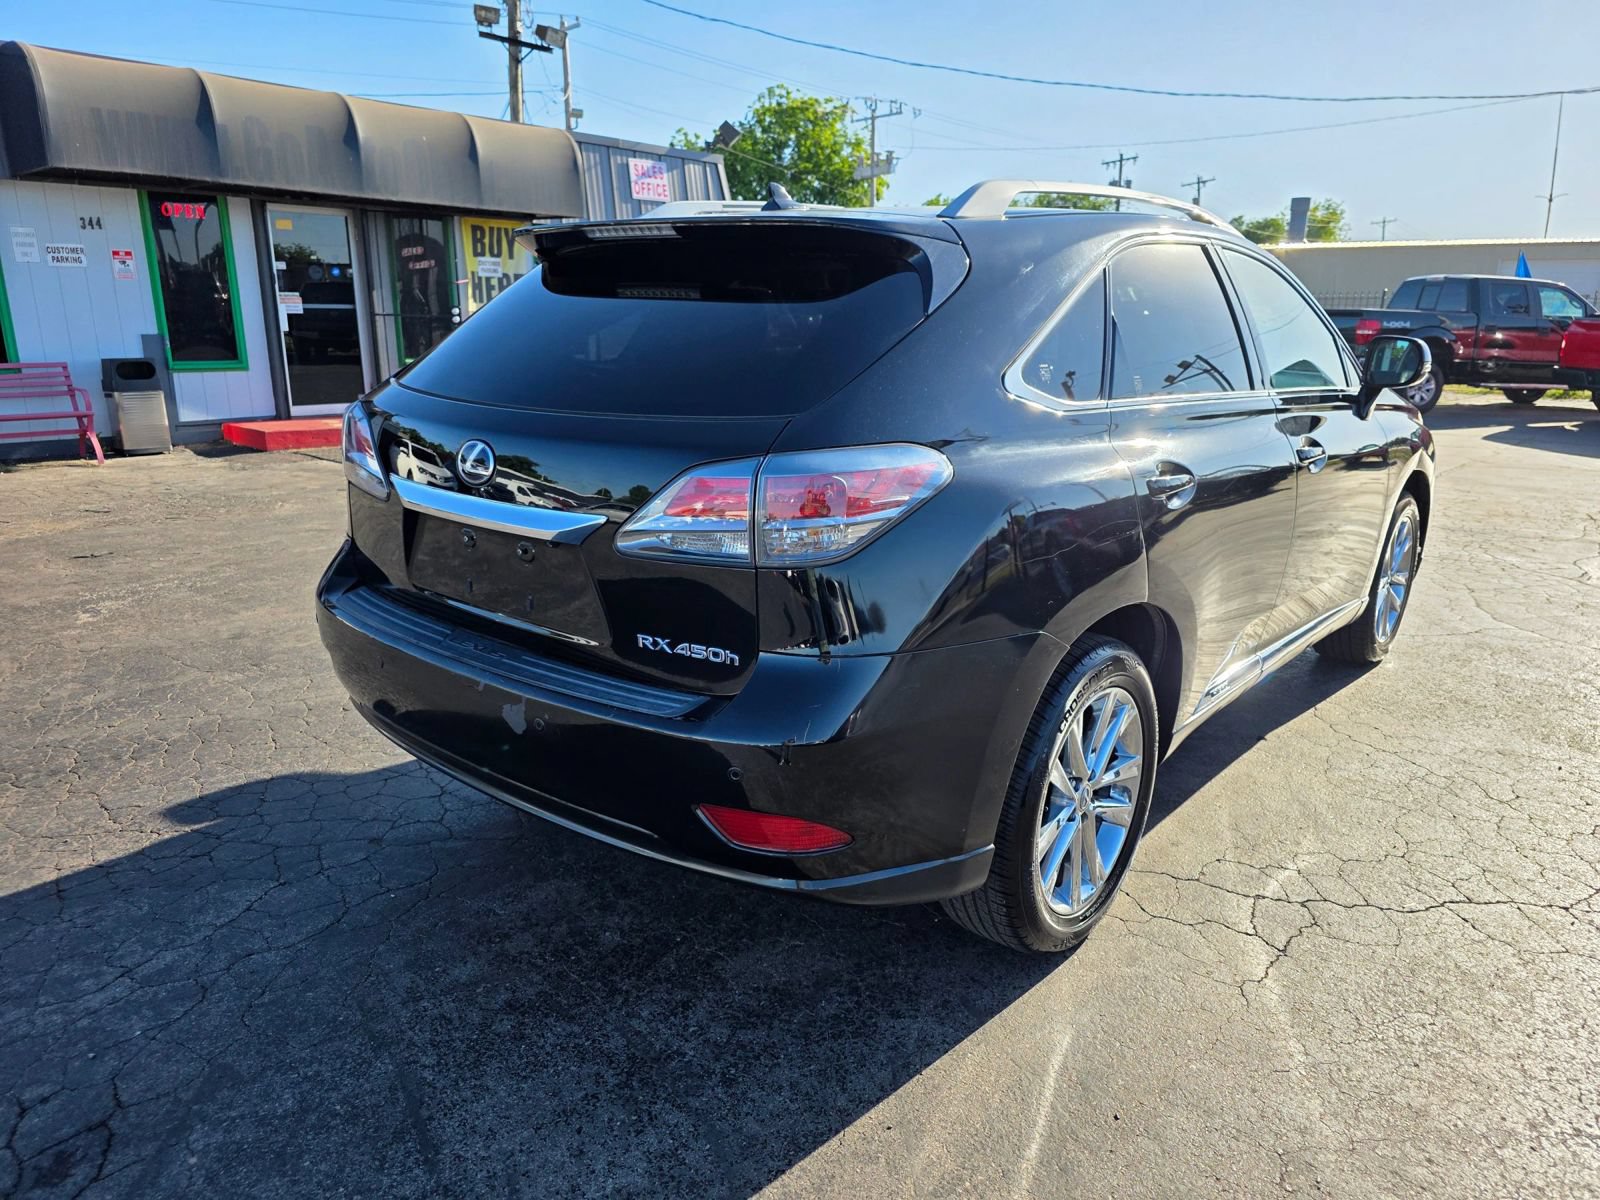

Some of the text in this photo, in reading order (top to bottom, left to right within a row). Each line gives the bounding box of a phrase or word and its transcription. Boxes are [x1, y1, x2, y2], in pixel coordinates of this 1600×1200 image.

[633, 163, 665, 181] SALES
[634, 181, 669, 199] OFFICE
[160, 201, 206, 219] OPEN
[79, 216, 103, 230] 344
[46, 246, 85, 255] CUSTOMER
[471, 224, 518, 260] BUY
[51, 255, 83, 265] PARKING
[637, 633, 740, 667] RX450h
